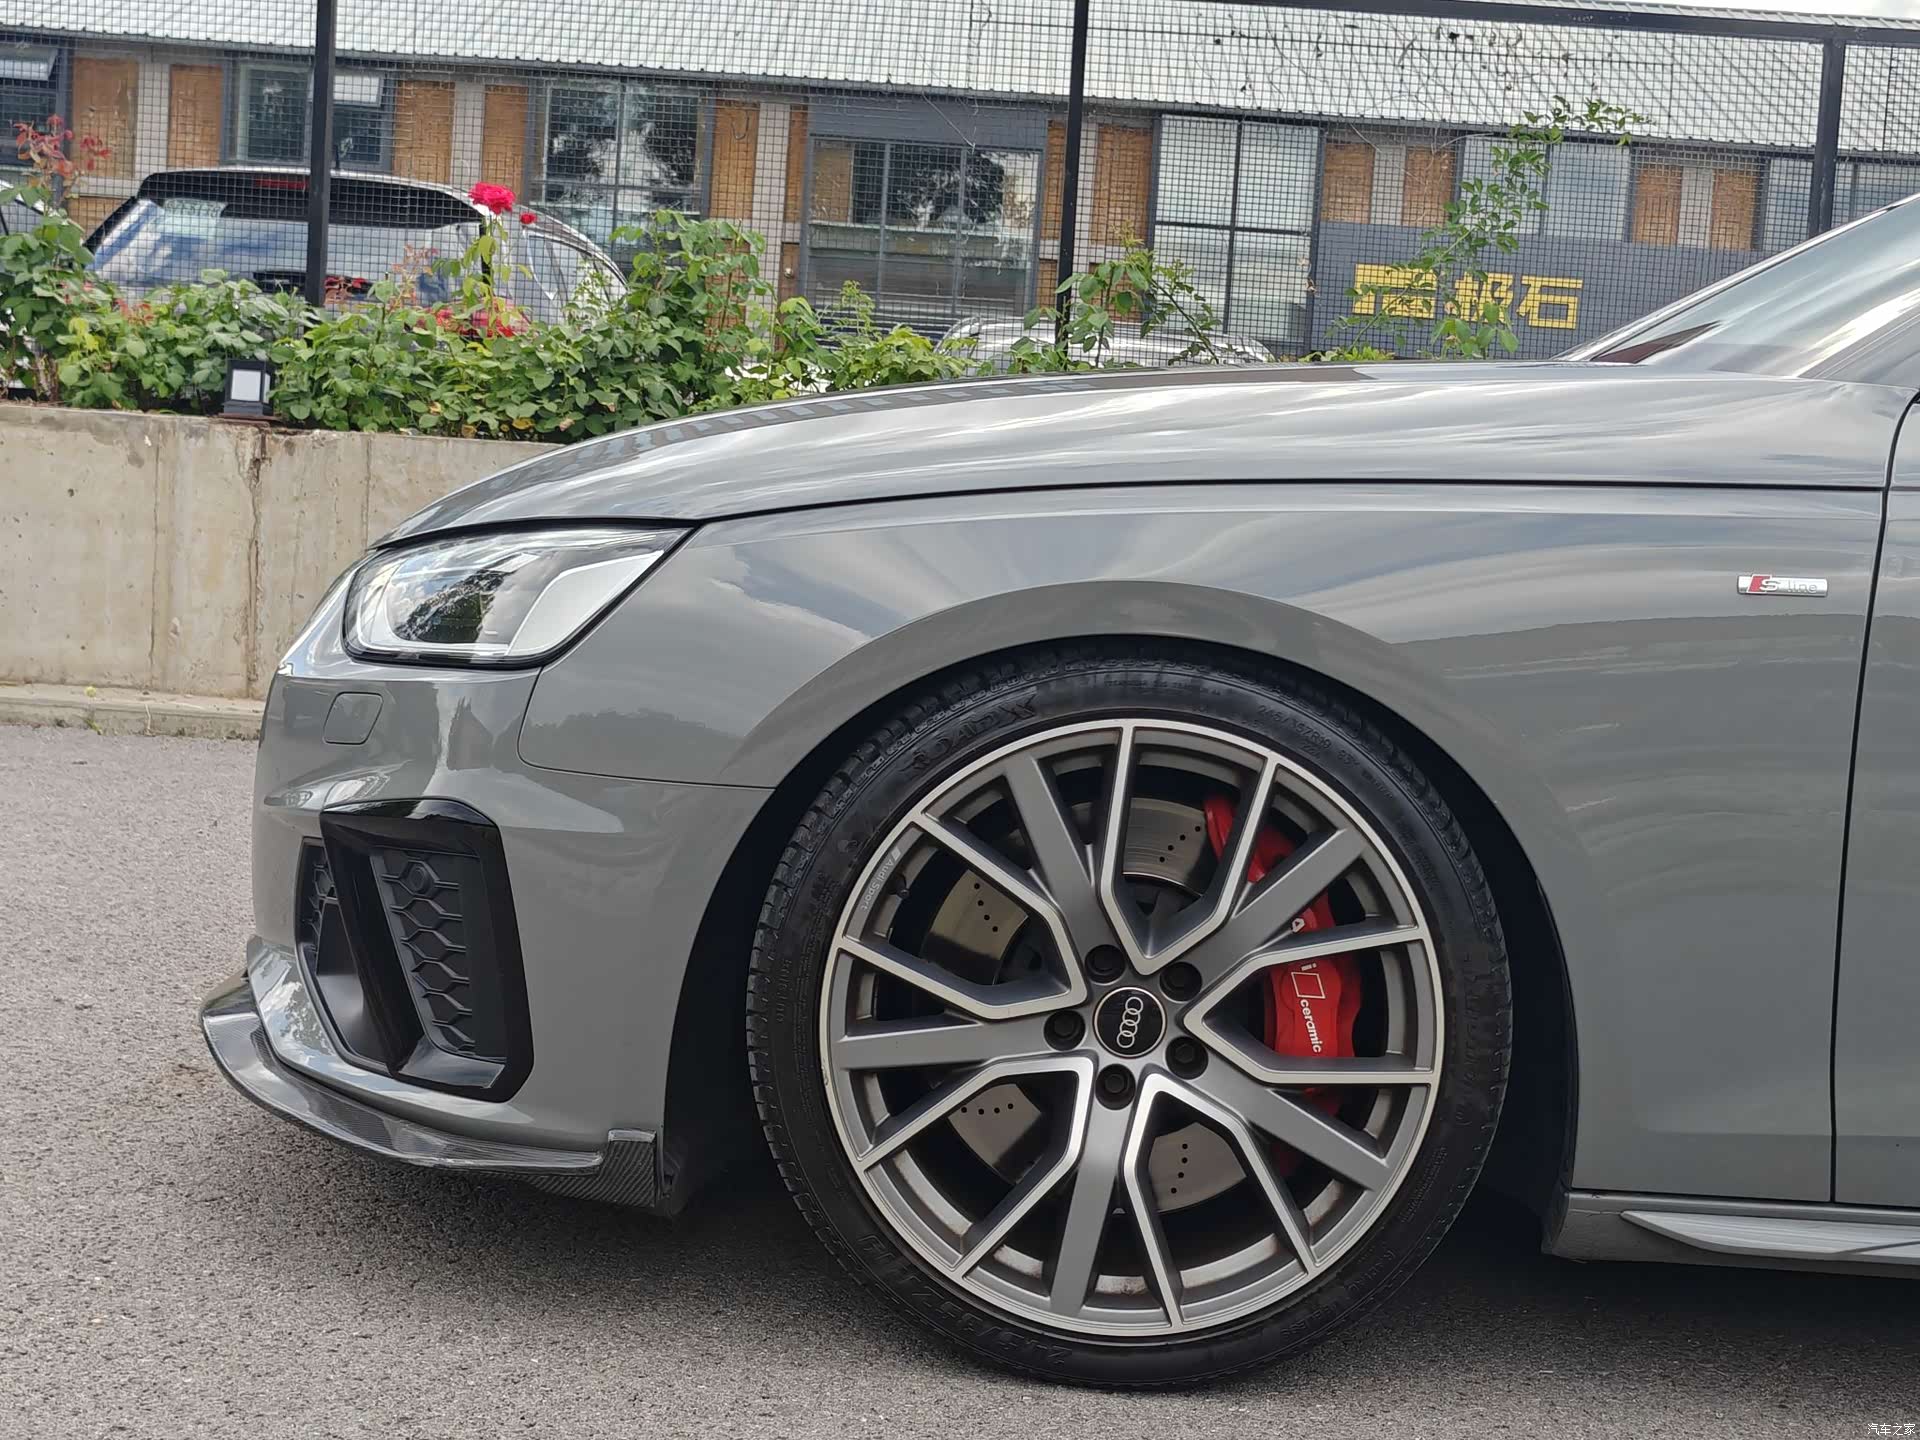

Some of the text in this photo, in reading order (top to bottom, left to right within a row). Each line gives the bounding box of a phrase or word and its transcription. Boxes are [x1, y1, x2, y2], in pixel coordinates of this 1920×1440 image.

[1786, 579, 1818, 594] line
[861, 859, 895, 911] Audi Sport
[1300, 999, 1323, 1053] ceramic
